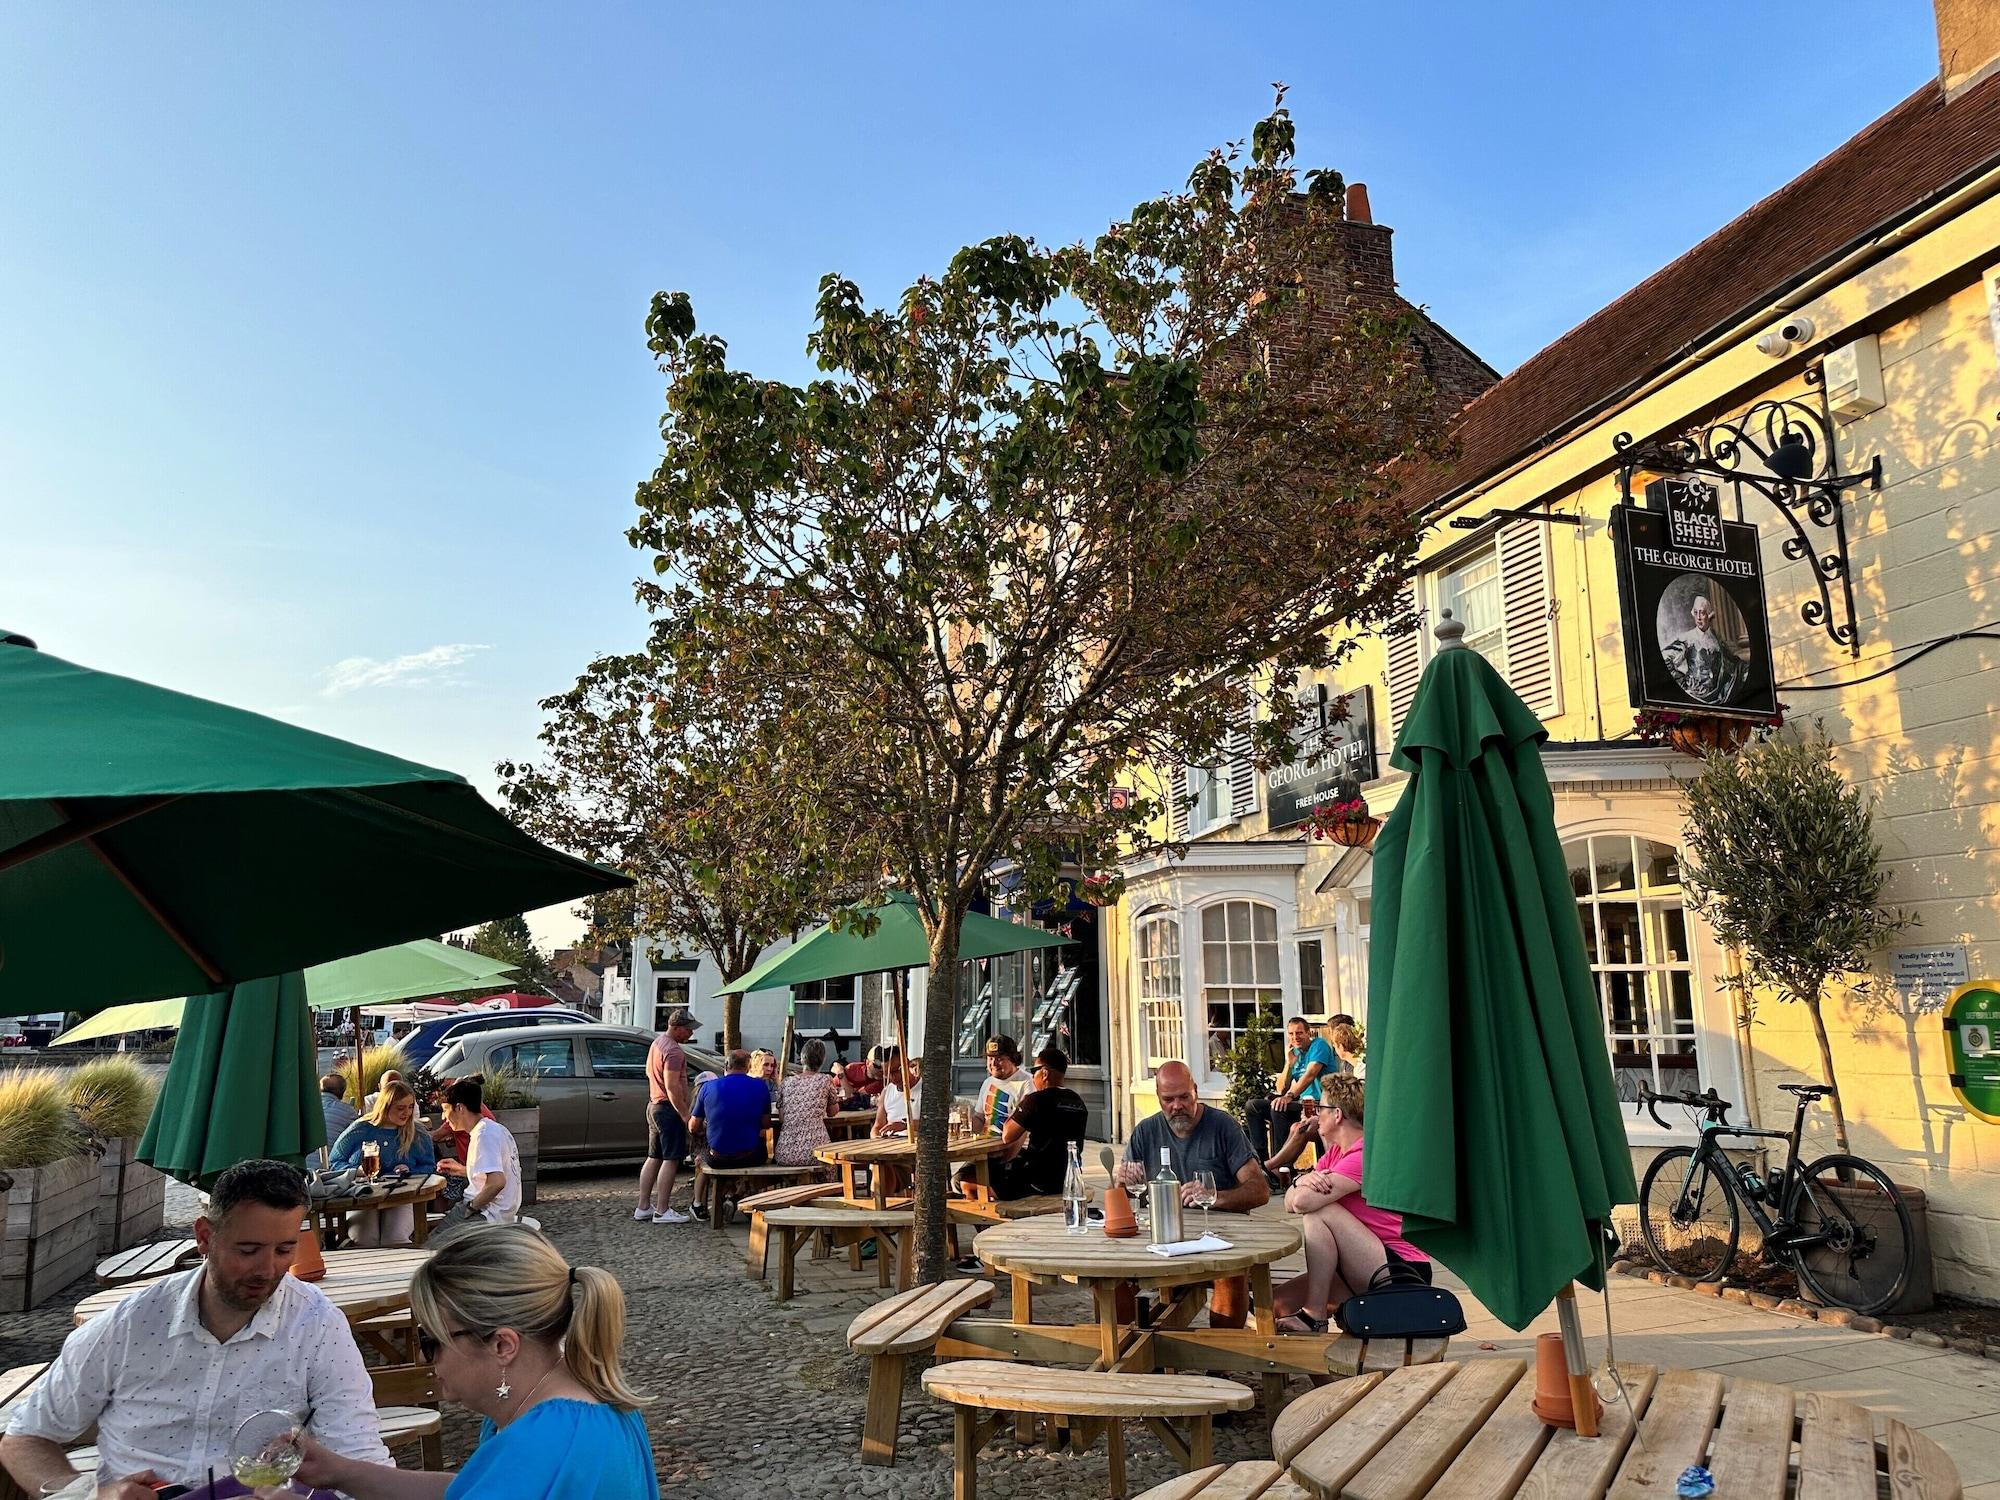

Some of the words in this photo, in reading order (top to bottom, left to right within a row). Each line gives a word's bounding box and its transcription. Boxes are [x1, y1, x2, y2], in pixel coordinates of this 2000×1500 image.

[1673, 510, 1718, 527] BLACK
[1675, 523, 1719, 540] SHEEP
[1676, 536, 1721, 546] BREWERY
[1634, 546, 1661, 563] THE
[1663, 550, 1713, 570] GEORGE
[1715, 558, 1756, 576] HOTEL
[1321, 739, 1368, 772] HOTEL
[1295, 795, 1313, 810] FREE
[1313, 786, 1340, 804] HOUSE
